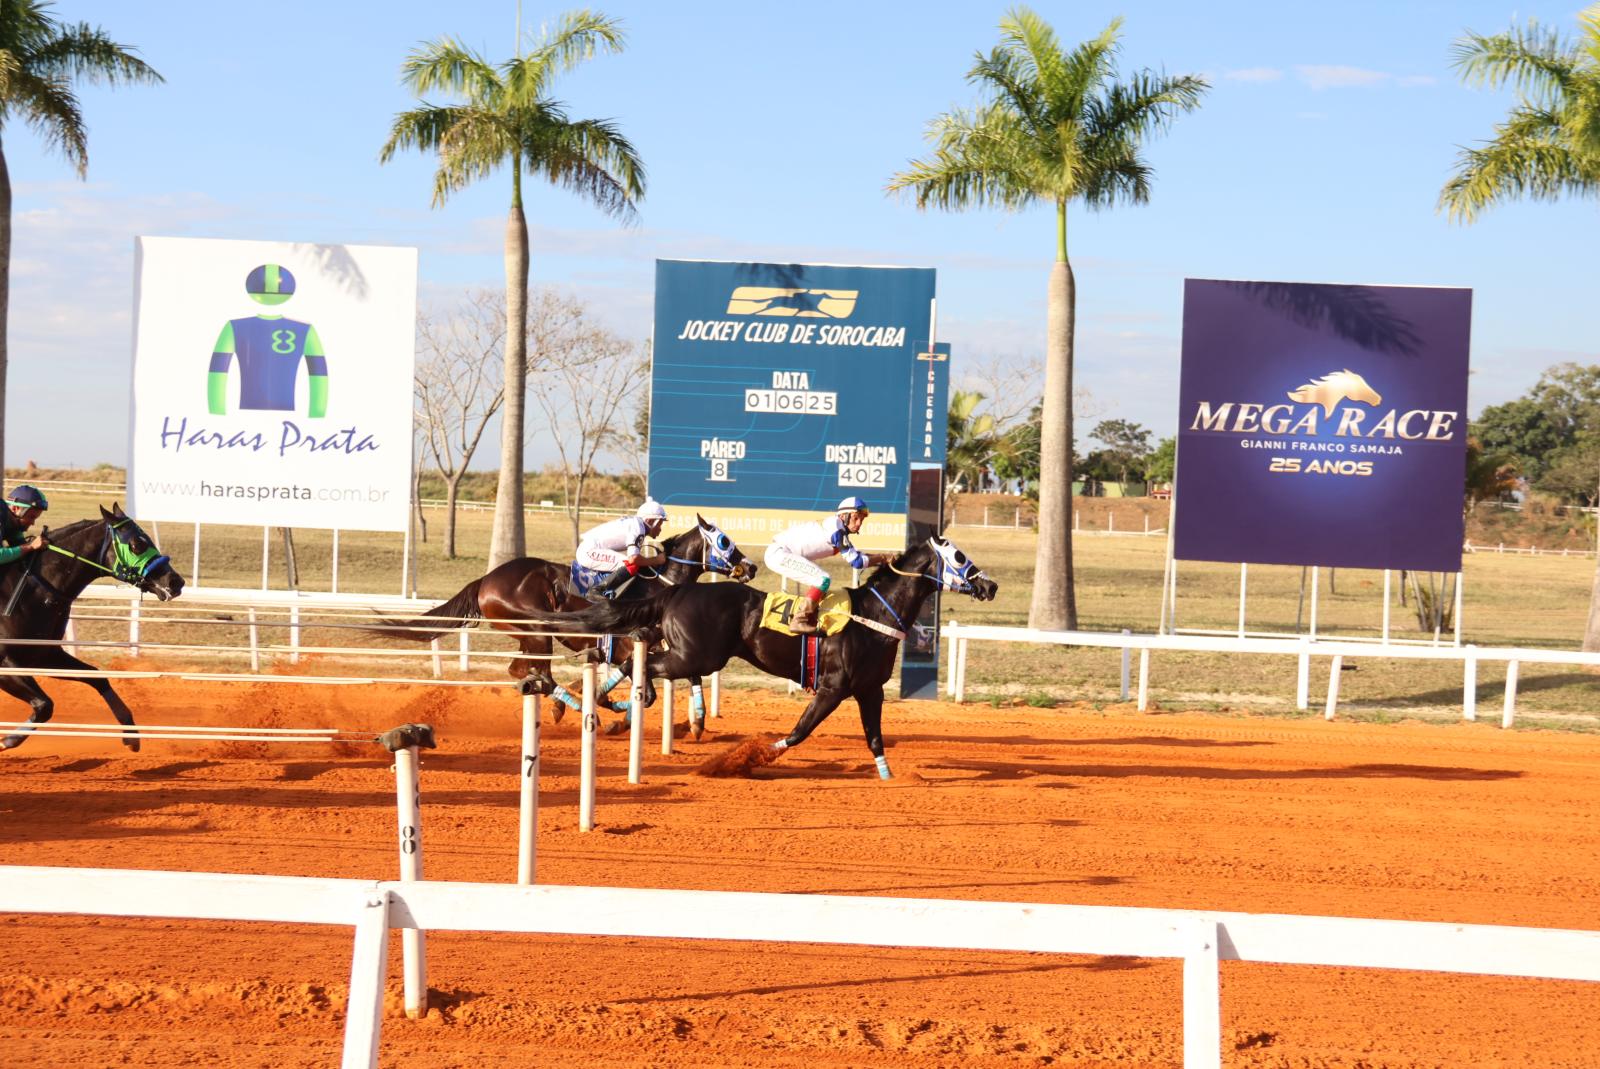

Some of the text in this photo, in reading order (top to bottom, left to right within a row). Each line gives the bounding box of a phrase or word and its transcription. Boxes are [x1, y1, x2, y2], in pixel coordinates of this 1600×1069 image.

[678, 320, 906, 348] JOCKEY CLUB DE SOROCABA
[772, 371, 809, 390] DATA
[924, 370, 935, 458] CHEGADA
[1189, 401, 1458, 441] MEGA RACE
[160, 416, 380, 457] Haras Prata
[1240, 439, 1403, 455] GIANNI FRANCO SAMAJA
[701, 437, 746, 459] PÁREO
[825, 442, 897, 465] DISTÂNCIA
[714, 462, 725, 477] 8
[840, 466, 883, 483] 402
[1269, 457, 1374, 476] 25 ANOS
[142, 480, 390, 502] www.harasprata.com.br
[722, 516, 766, 531] QUARTO
[769, 519, 784, 532] DE
[770, 598, 795, 626] 4
[635, 686, 643, 701] 5
[584, 713, 596, 733] 6
[524, 755, 537, 777] 7
[402, 825, 416, 854] 8
